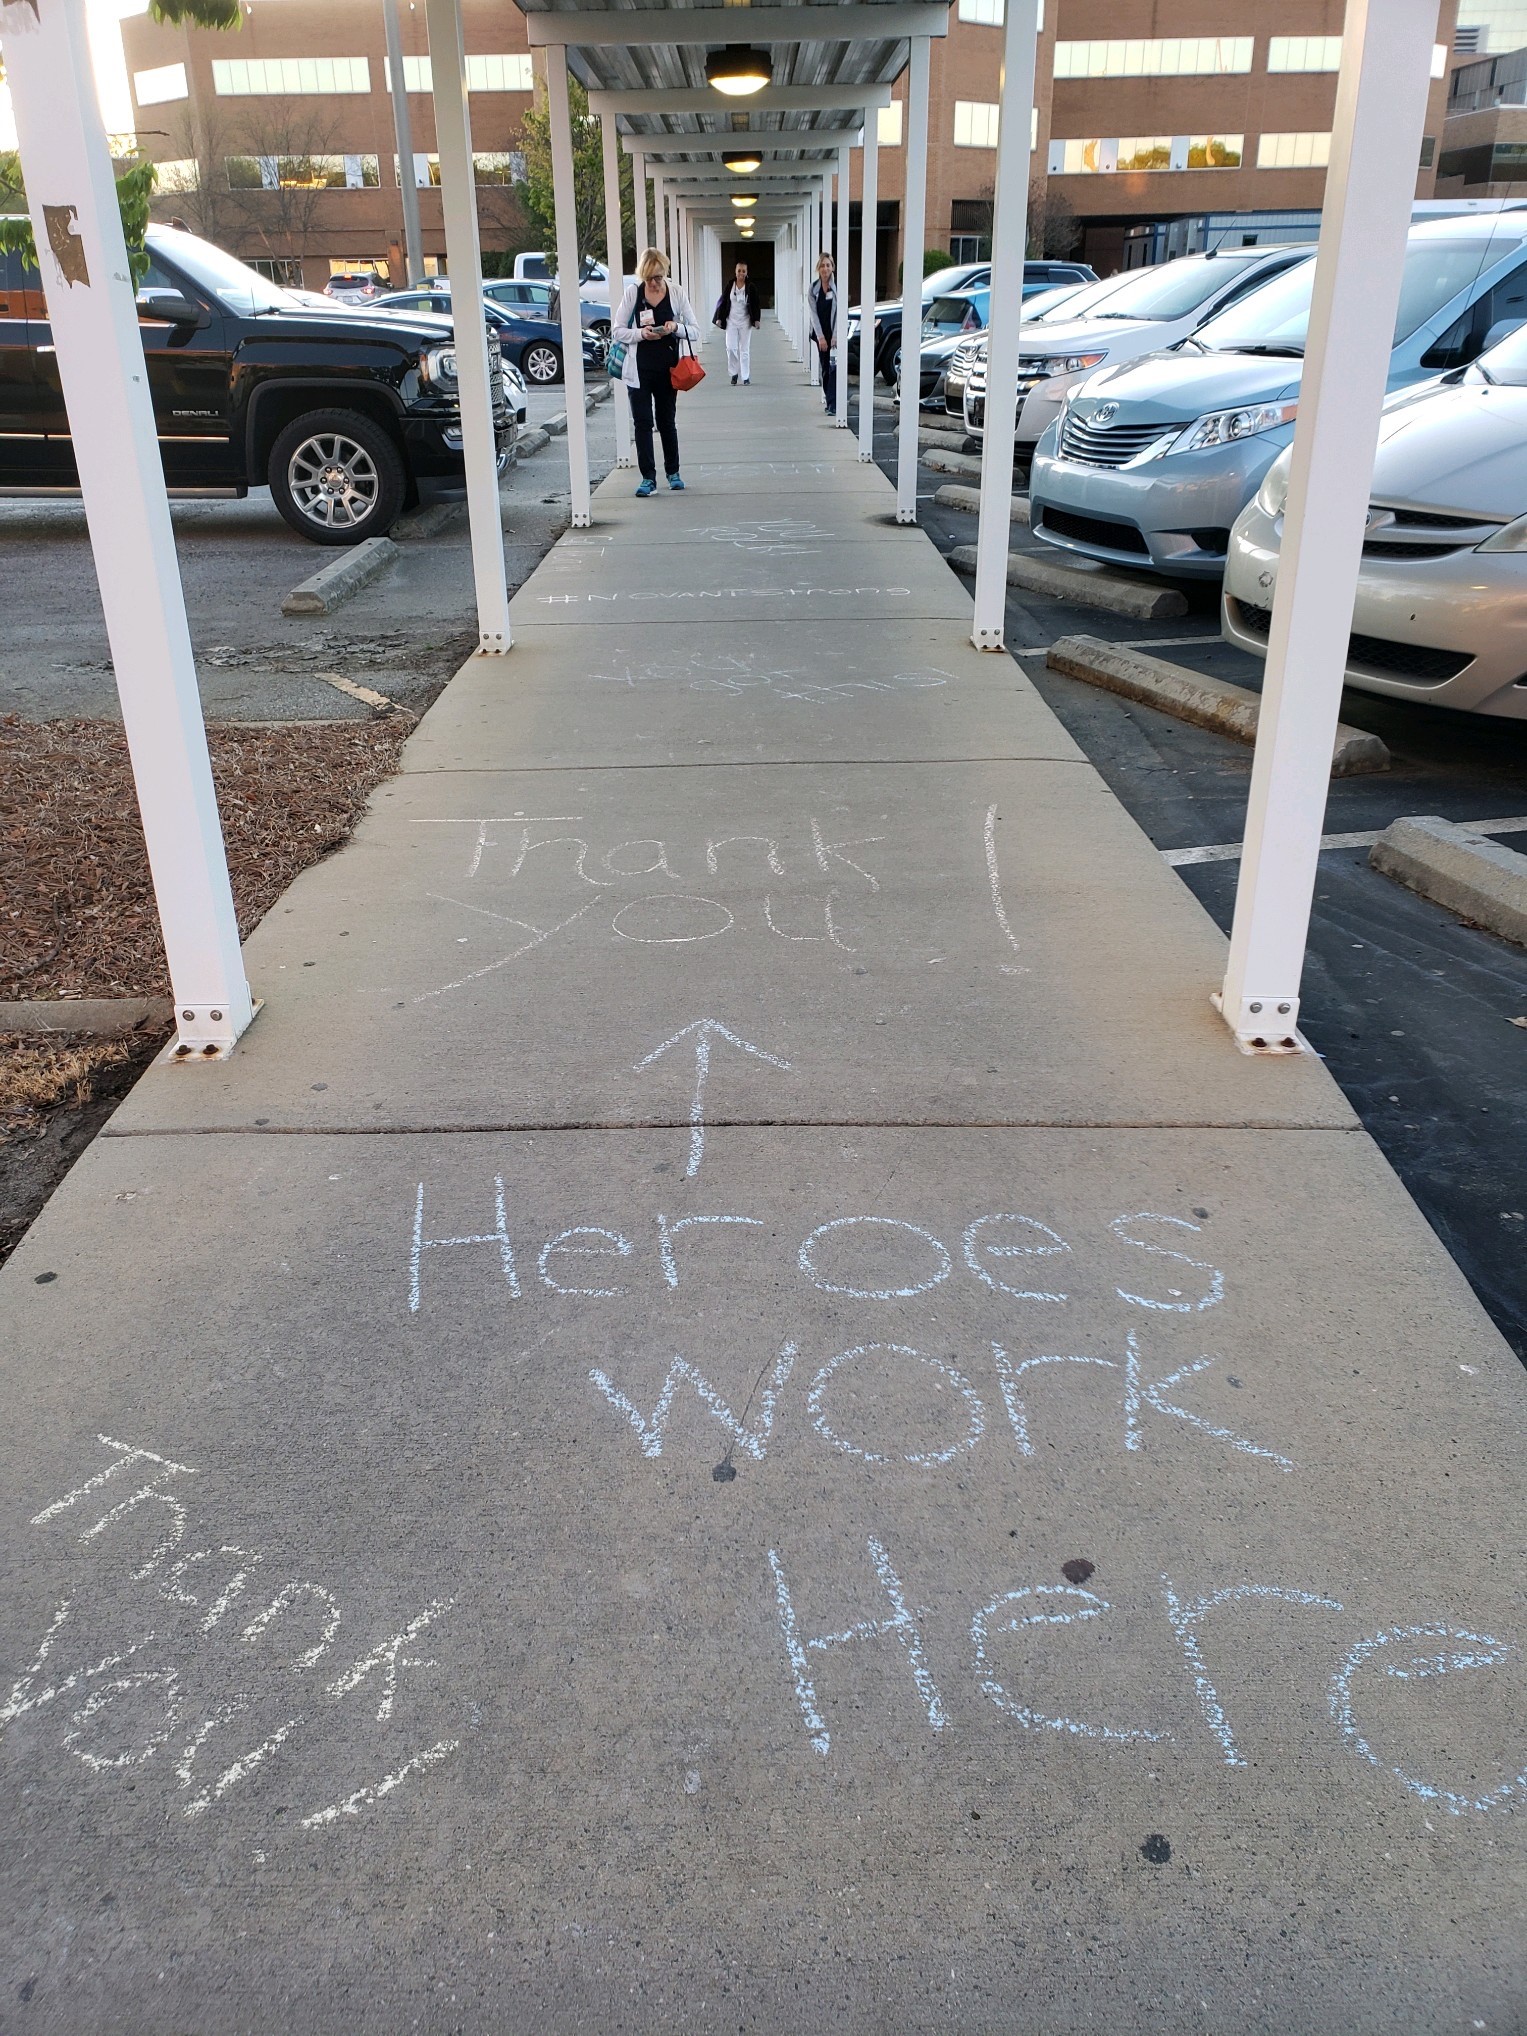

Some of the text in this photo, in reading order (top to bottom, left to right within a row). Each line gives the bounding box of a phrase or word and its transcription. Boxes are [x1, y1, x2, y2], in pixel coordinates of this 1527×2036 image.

[409, 816, 886, 892] Thank
[407, 1173, 1226, 1313] Heroes
[30, 1433, 456, 1722] Thank
[768, 1535, 1527, 1814] Here
